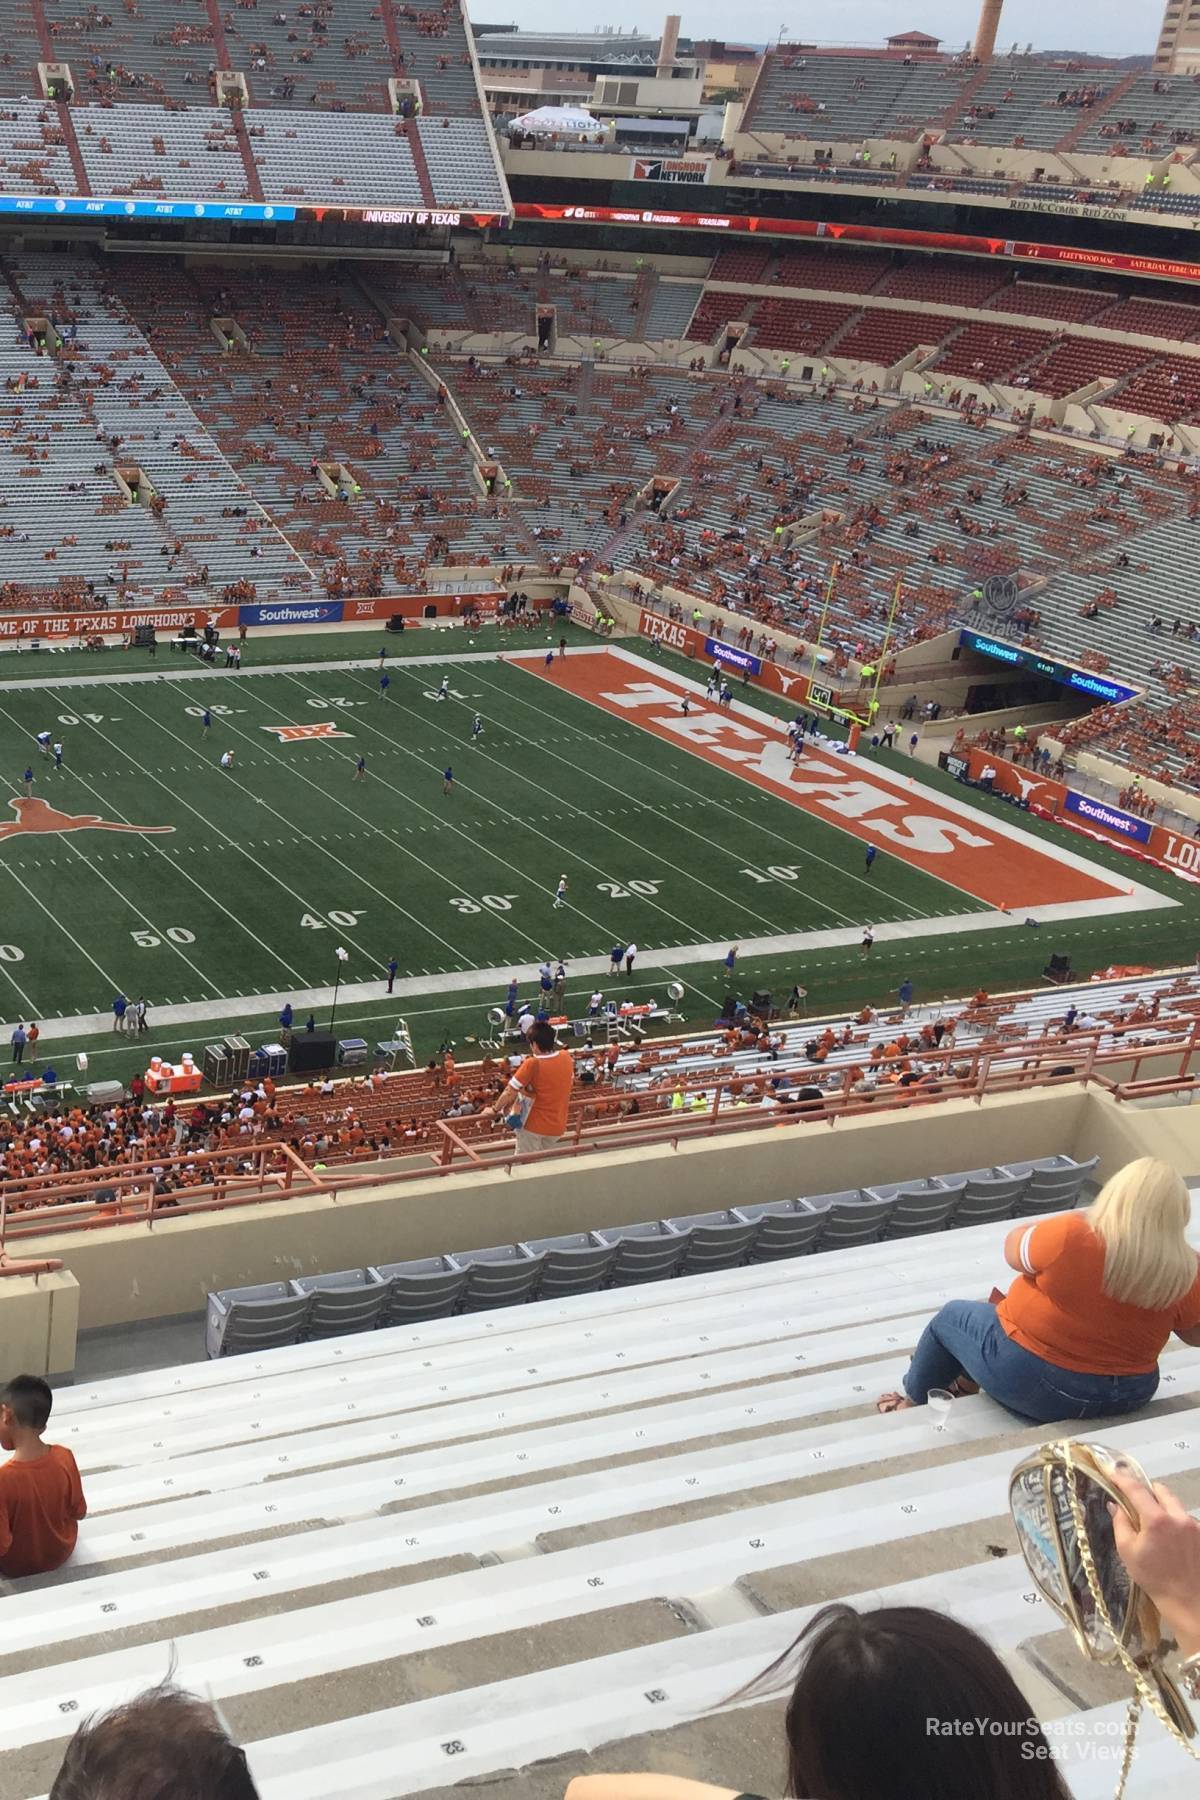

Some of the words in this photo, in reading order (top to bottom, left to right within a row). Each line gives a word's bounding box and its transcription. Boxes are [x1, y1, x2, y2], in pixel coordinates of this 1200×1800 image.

[662, 160, 707, 172] LONGHORN
[661, 171, 705, 183] NETWORK
[15, 200, 34, 209] AT&T
[85, 203, 105, 211] AT&T
[155, 205, 174, 213] AT&T
[224, 207, 243, 215] AT&T
[1009, 200, 1030, 210] RED
[1082, 208, 1100, 218] RED
[1102, 209, 1127, 221] ZONE
[362, 211, 414, 224] UNIVERSITY
[415, 212, 429, 224] OF
[431, 213, 460, 225] TEXAS
[259, 606, 320, 621] Southwest
[22, 620, 38, 634] OF
[44, 618, 69, 632] THE
[74, 617, 117, 631] TEXAS
[122, 613, 196, 629] LONGHORNS
[643, 613, 687, 648] TEXAS
[962, 609, 1018, 637] Allstate
[713, 644, 748, 666] Southwest
[975, 638, 1019, 661] Southwest
[1070, 673, 1119, 698] Southwest
[600, 682, 995, 853] TEXAS
[1078, 800, 1131, 831] Southwest
[738, 865, 798, 884] 10
[597, 879, 660, 898] 20
[448, 894, 513, 914] 30
[299, 910, 358, 931] 40
[129, 926, 196, 948] 50
[748, 1538, 766, 1550] 29
[252, 1570, 271, 1581] 31
[586, 1576, 605, 1588] 30
[1023, 1592, 1042, 1604] 29
[99, 1602, 118, 1614] 32
[415, 1615, 438, 1628] 31
[241, 1654, 265, 1668] 32
[642, 1688, 670, 1705] 31
[57, 1699, 80, 1714] 33
[439, 1739, 468, 1757] 32
